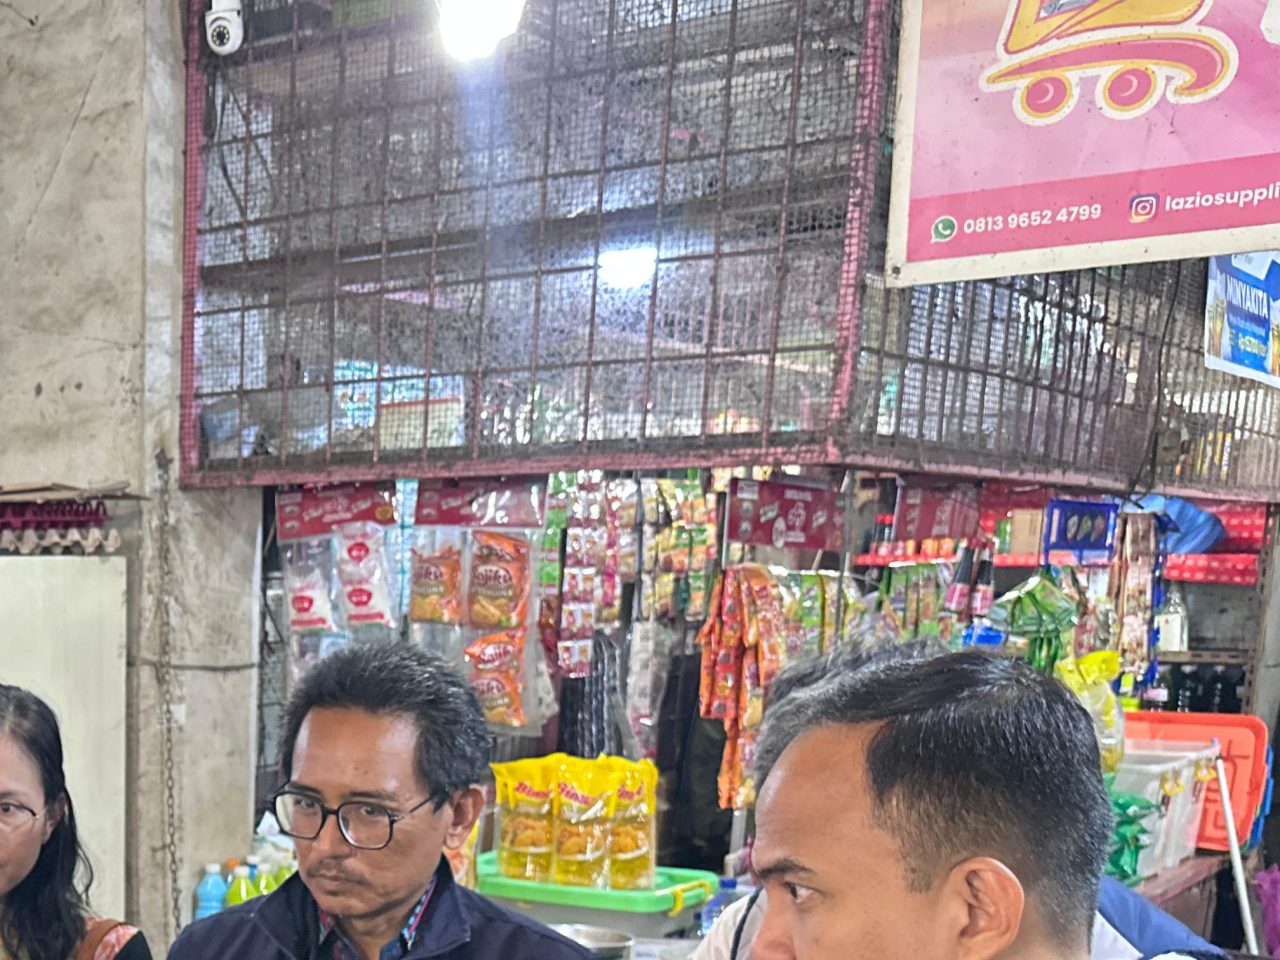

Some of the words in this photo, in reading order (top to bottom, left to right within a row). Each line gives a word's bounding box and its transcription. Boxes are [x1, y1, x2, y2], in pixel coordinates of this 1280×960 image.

[963, 215, 1004, 234] 0813
[1007, 209, 1052, 229] 9652
[1055, 203, 1102, 223] 4799
